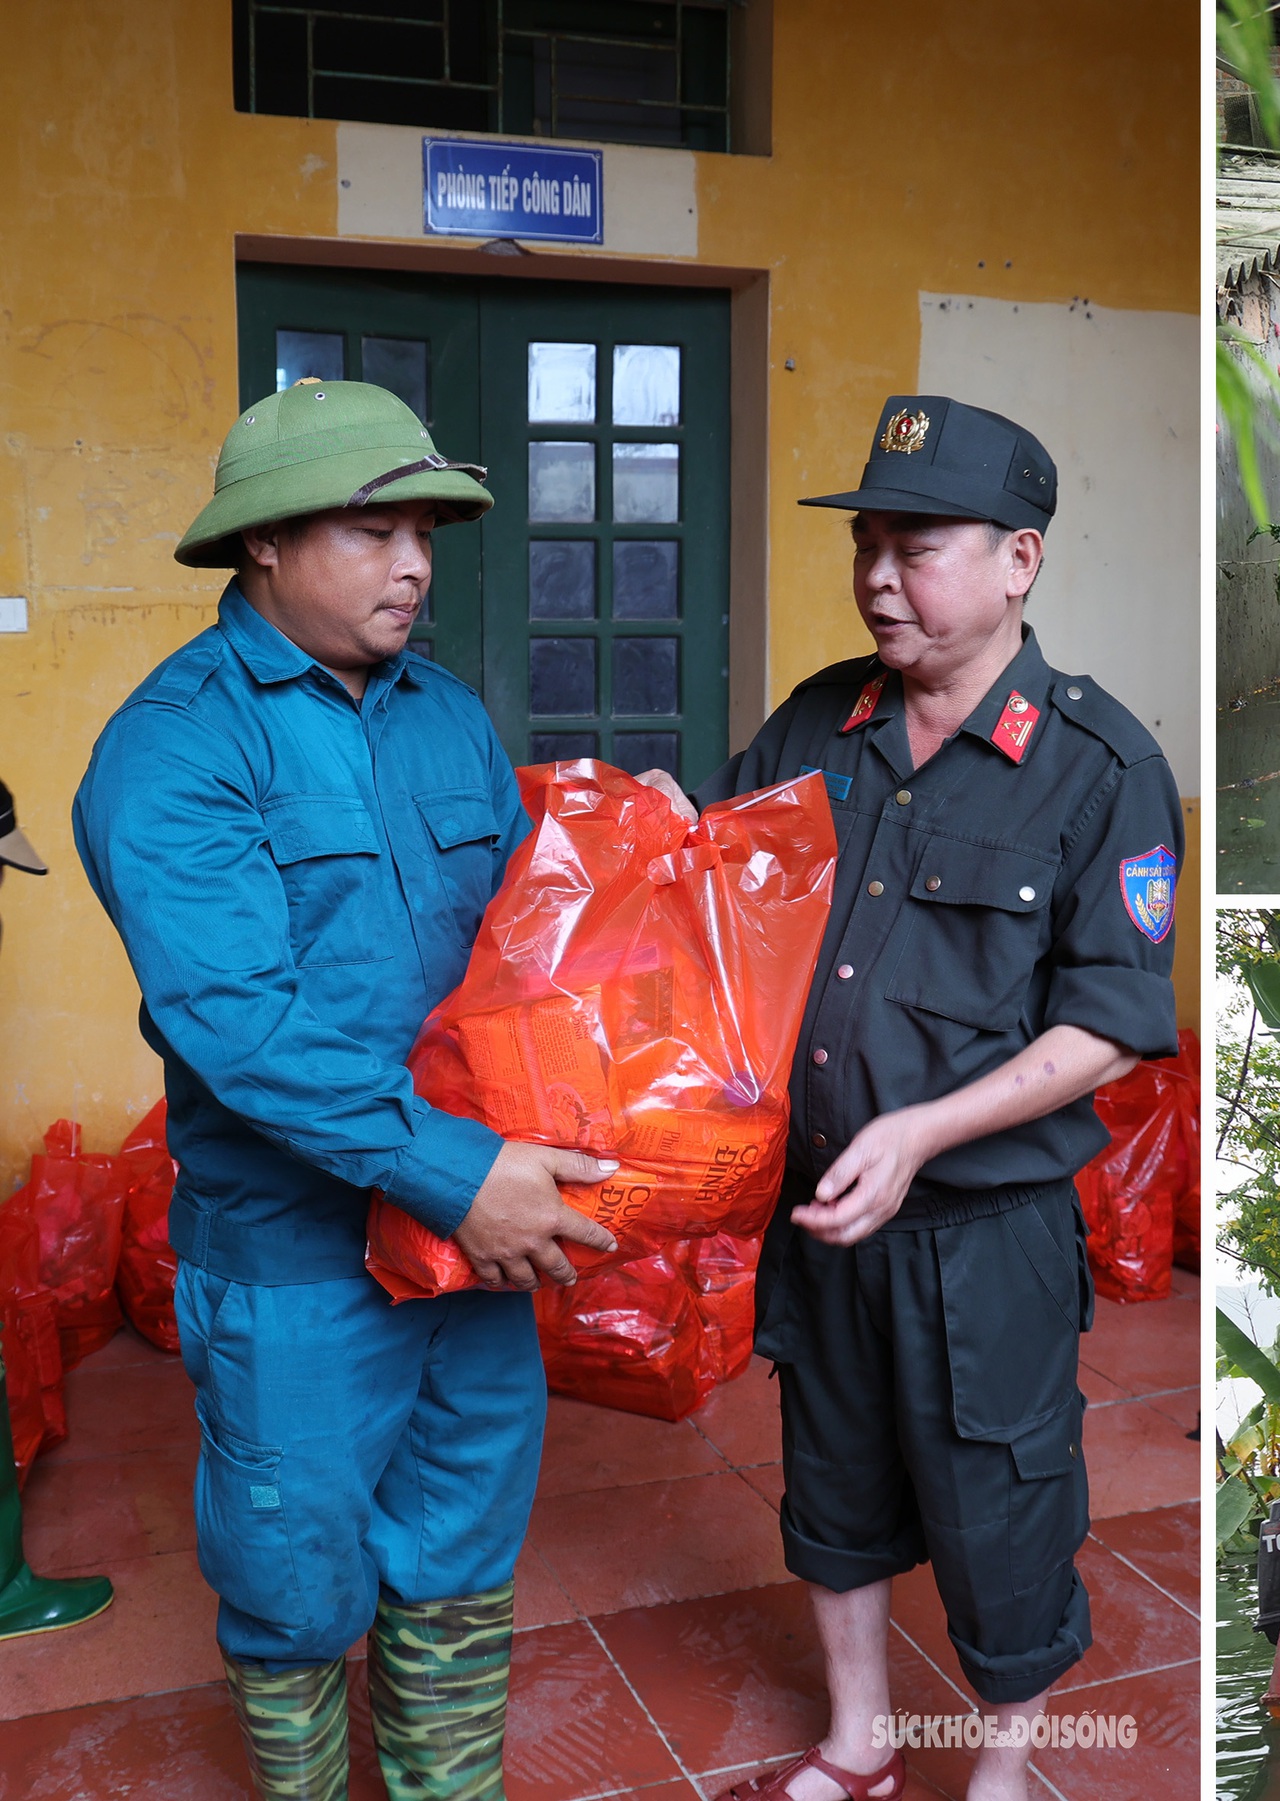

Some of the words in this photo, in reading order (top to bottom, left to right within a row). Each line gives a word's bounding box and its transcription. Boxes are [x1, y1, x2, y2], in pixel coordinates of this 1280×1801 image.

[437, 164, 486, 210] PHÒNG
[488, 164, 519, 212] TIẾP
[522, 171, 560, 215] CÔNG
[563, 174, 591, 217] DÂN
[1126, 864, 1149, 877] CẢNH
[595, 1185, 625, 1228] ĐÌN
